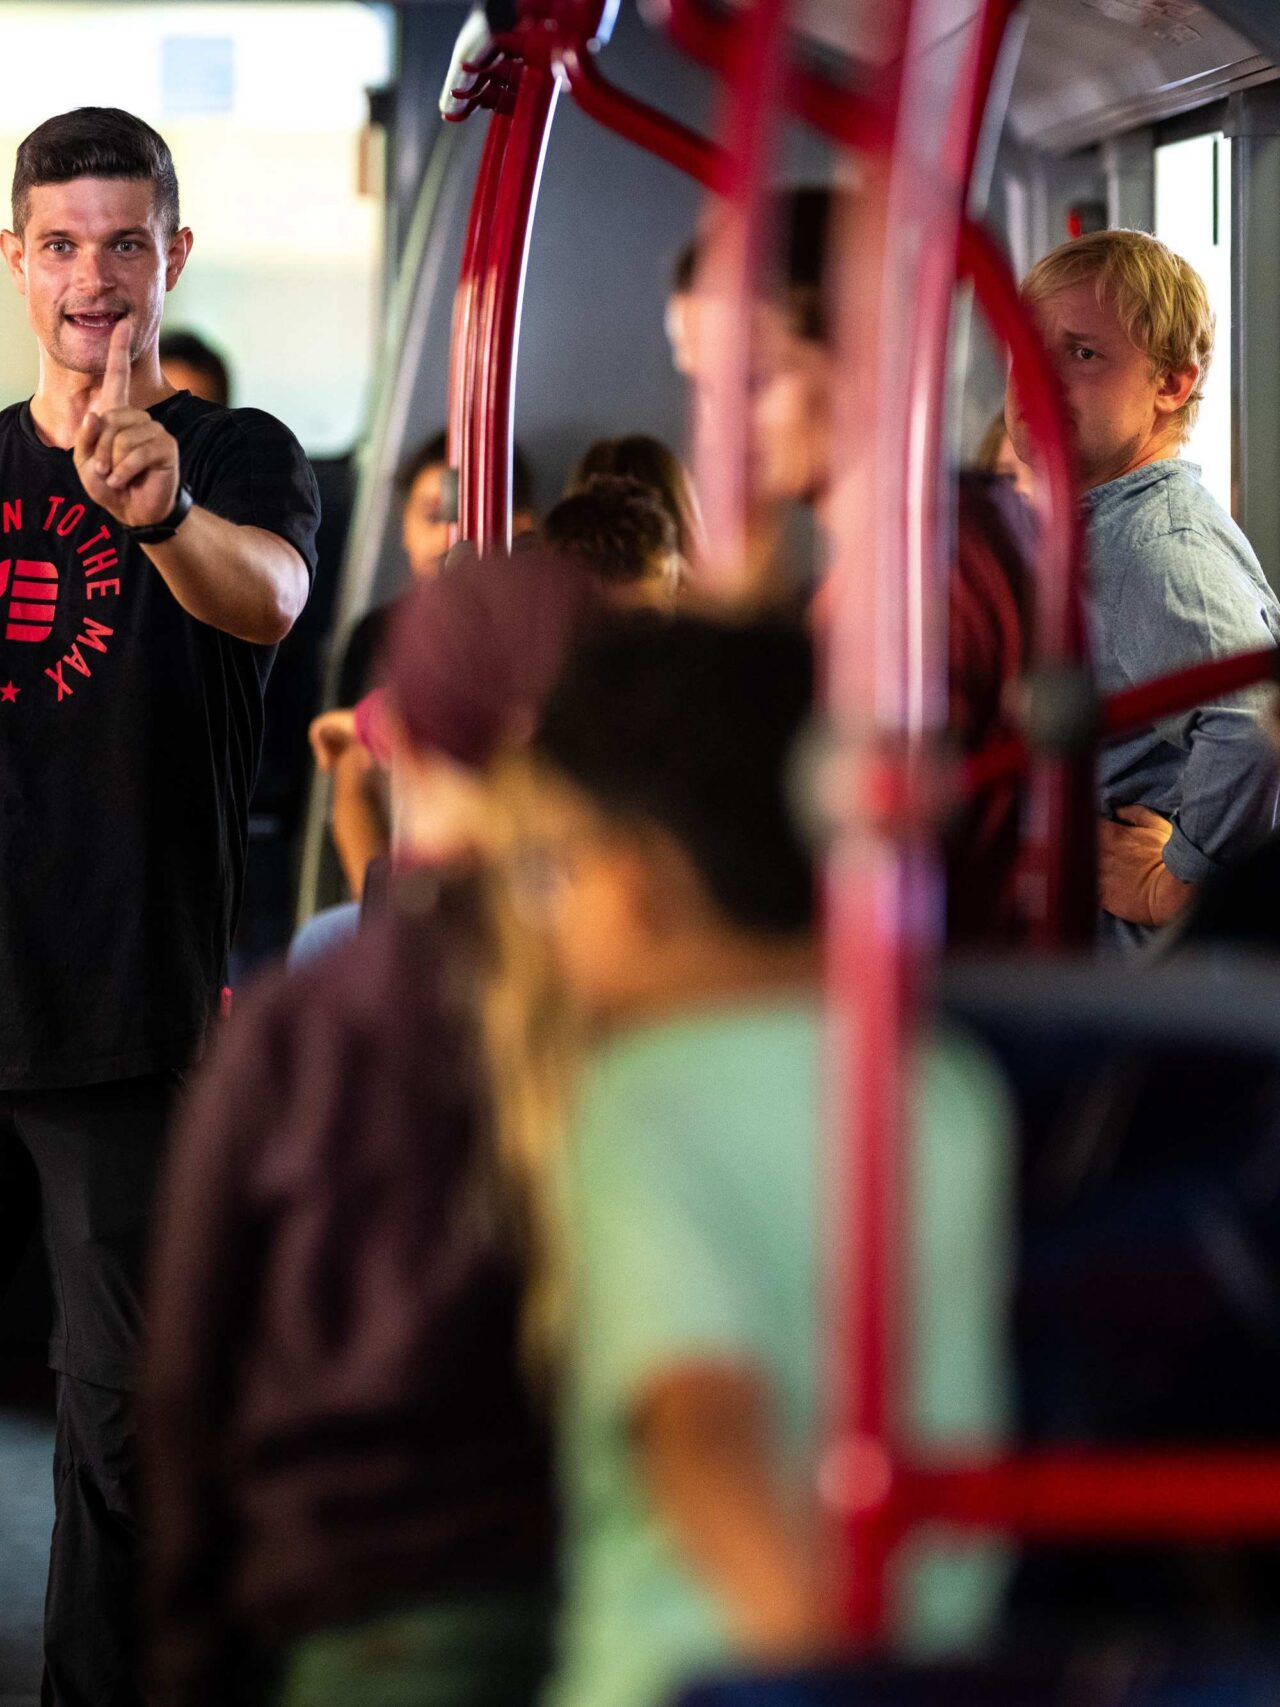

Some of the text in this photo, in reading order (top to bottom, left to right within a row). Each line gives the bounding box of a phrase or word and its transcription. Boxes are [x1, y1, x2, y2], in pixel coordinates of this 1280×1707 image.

[42, 495, 86, 537] TO
[76, 524, 121, 601] THE
[43, 616, 115, 702] MAX
